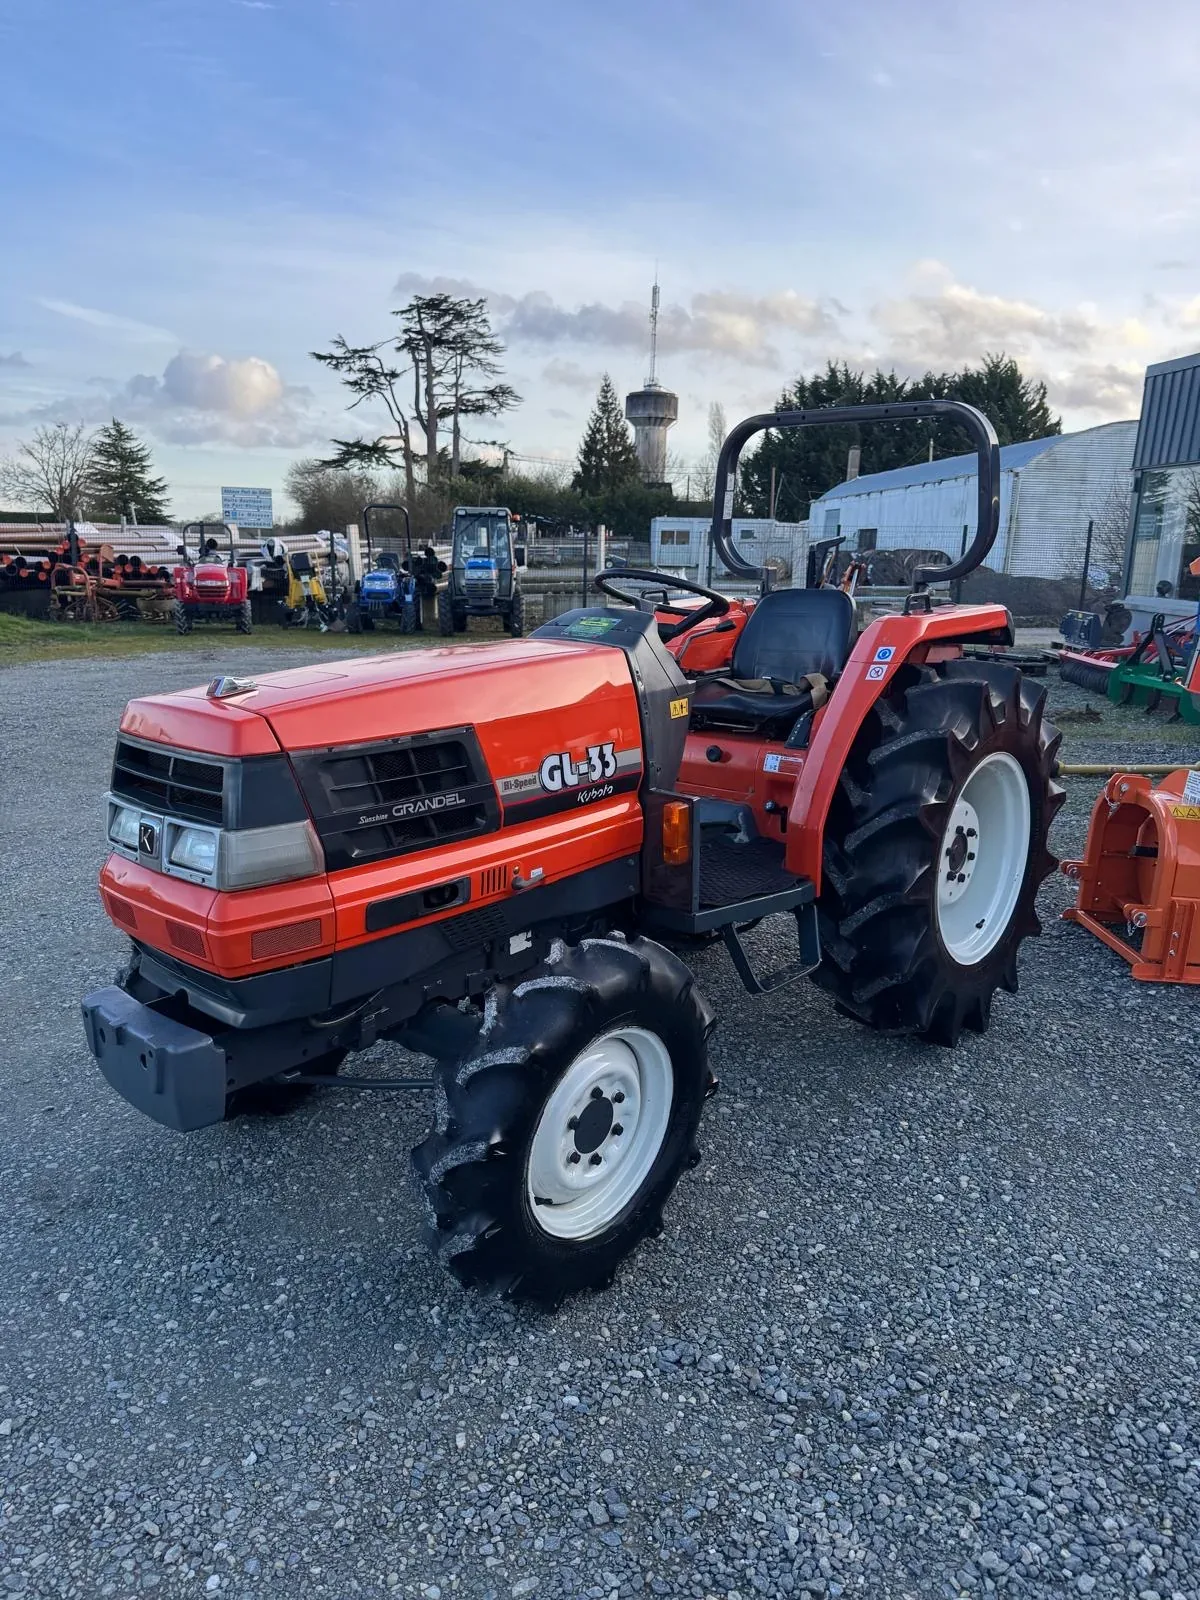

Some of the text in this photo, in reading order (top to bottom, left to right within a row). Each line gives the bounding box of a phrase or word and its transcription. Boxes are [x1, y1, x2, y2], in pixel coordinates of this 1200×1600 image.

[540, 743, 616, 792] GL-33
[502, 775, 537, 791] Hi-Speed
[577, 784, 614, 802] Kubota
[358, 793, 466, 825] Sunshine GRANDEL
